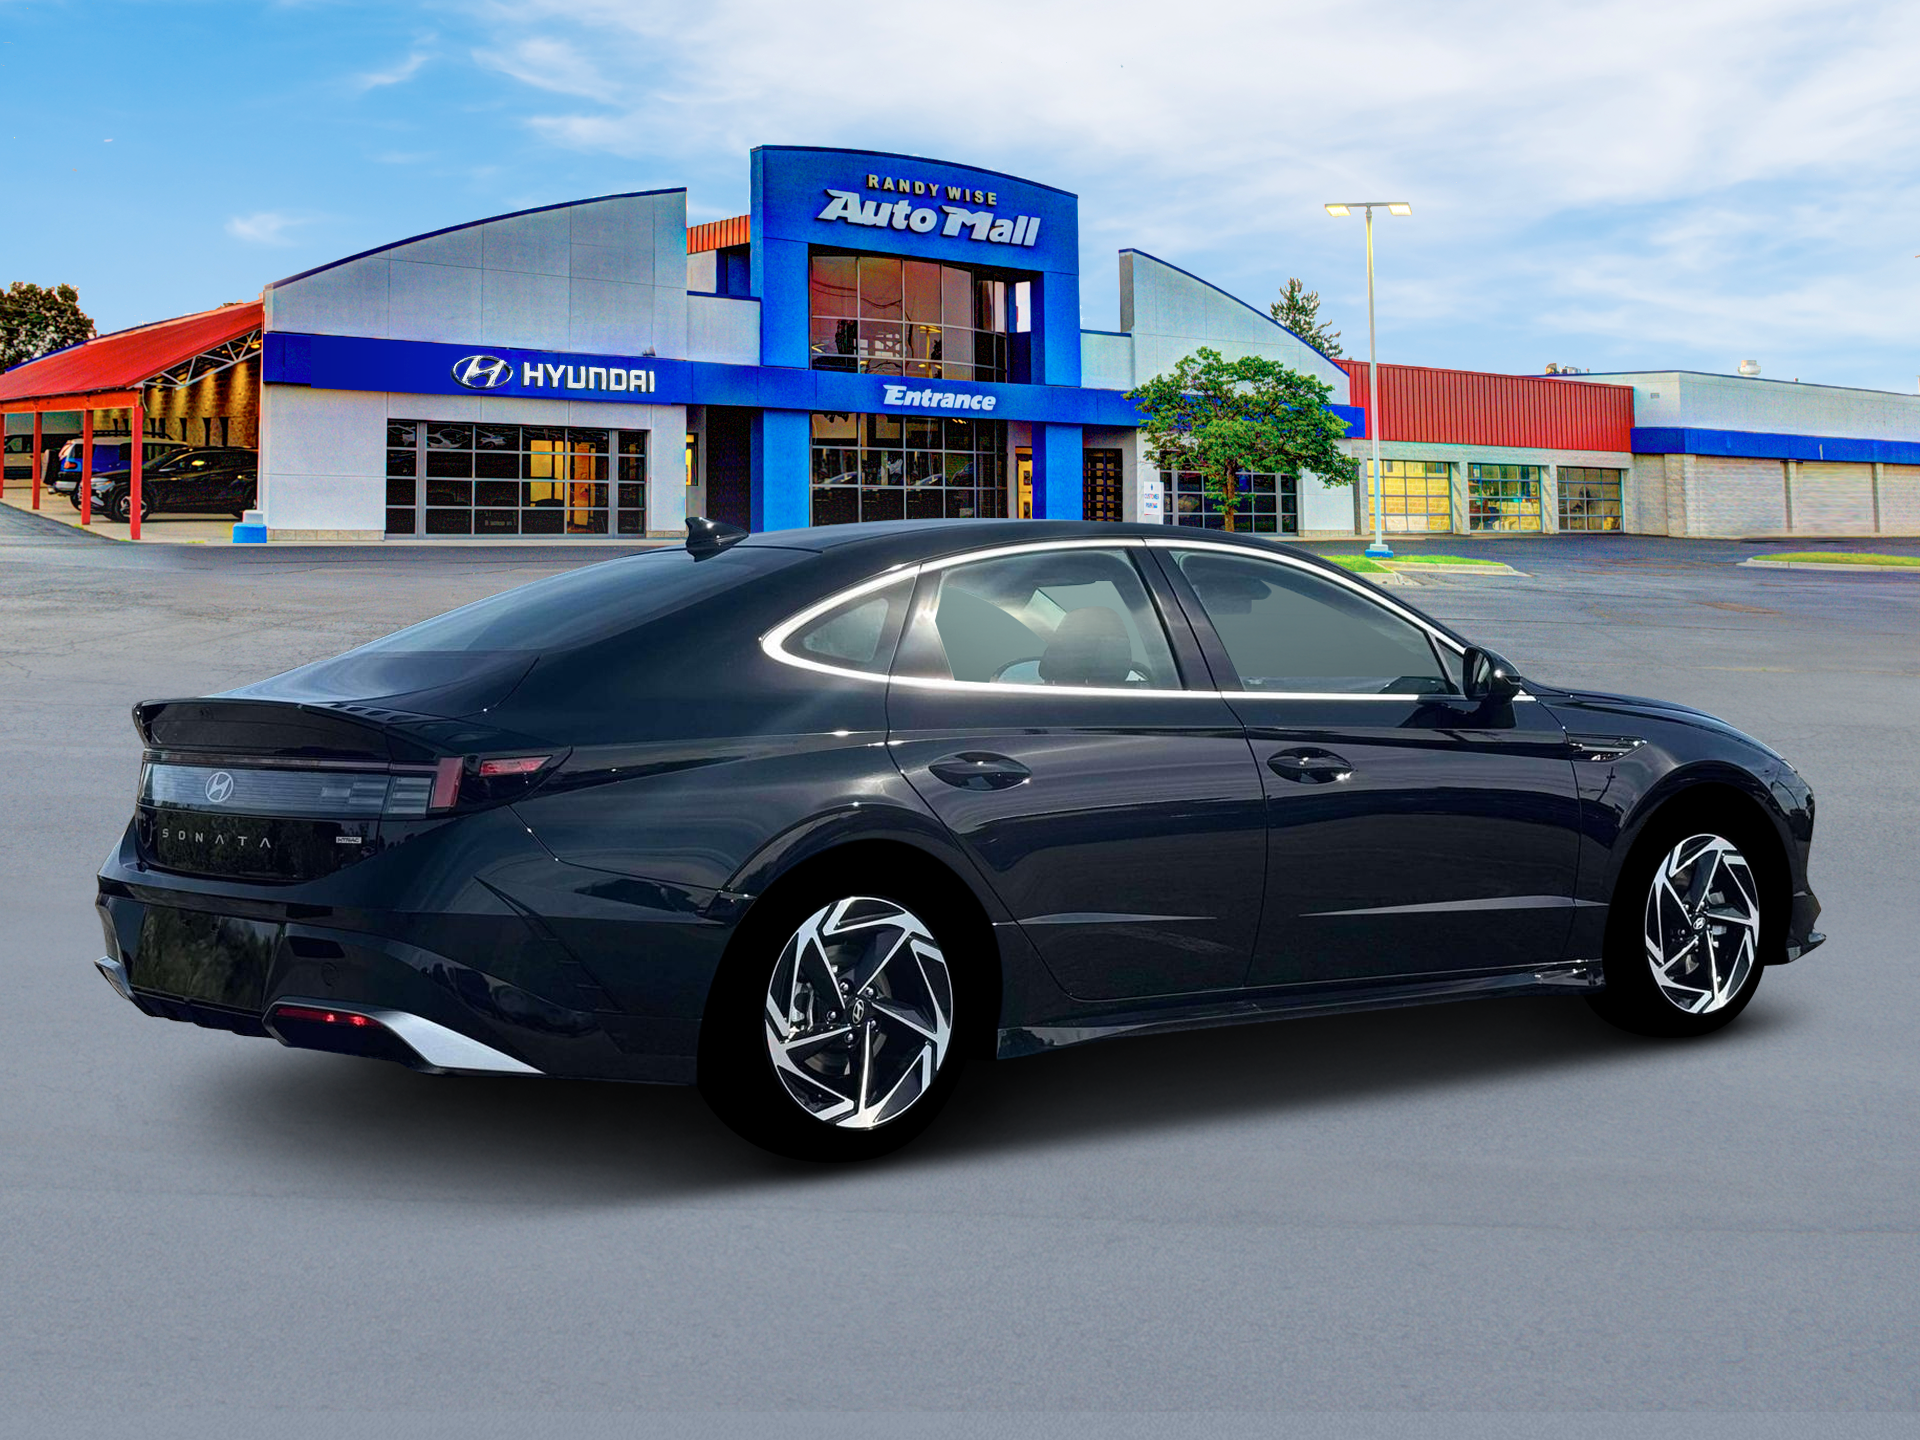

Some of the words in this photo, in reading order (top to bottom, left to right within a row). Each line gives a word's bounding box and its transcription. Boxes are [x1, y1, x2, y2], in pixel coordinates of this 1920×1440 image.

[867, 174, 939, 196] RANDY
[947, 186, 997, 205] WISE
[817, 189, 938, 233] Auto
[941, 205, 1041, 246] Mall
[523, 362, 656, 392] HYUNDAI
[883, 384, 996, 411] Entrance
[162, 828, 271, 849] SONATA
